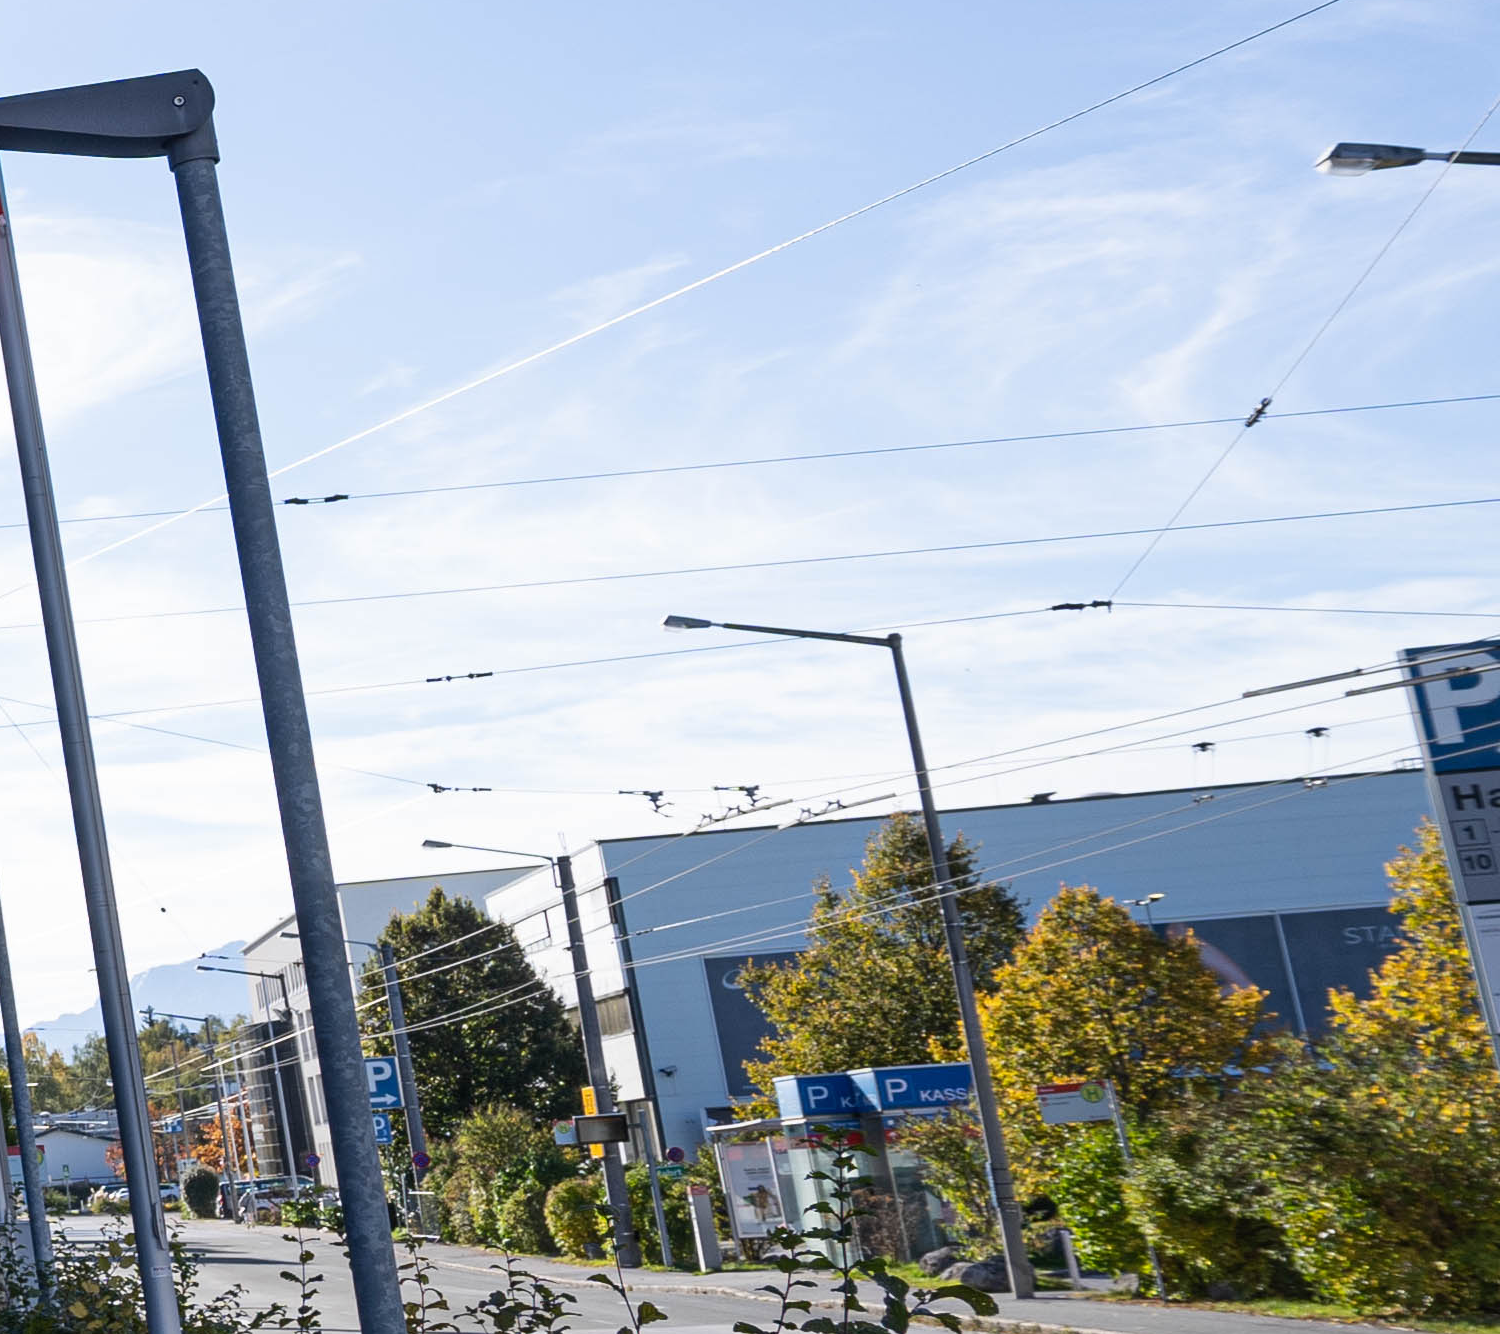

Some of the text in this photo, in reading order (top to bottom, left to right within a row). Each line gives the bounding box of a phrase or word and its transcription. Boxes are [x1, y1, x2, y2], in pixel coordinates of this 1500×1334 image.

[1417, 650, 1500, 744] P
[1462, 825, 1476, 841] 1
[1463, 854, 1492, 871] 10
[365, 1061, 393, 1093] P
[807, 1086, 829, 1109] P
[884, 1078, 909, 1103] P
